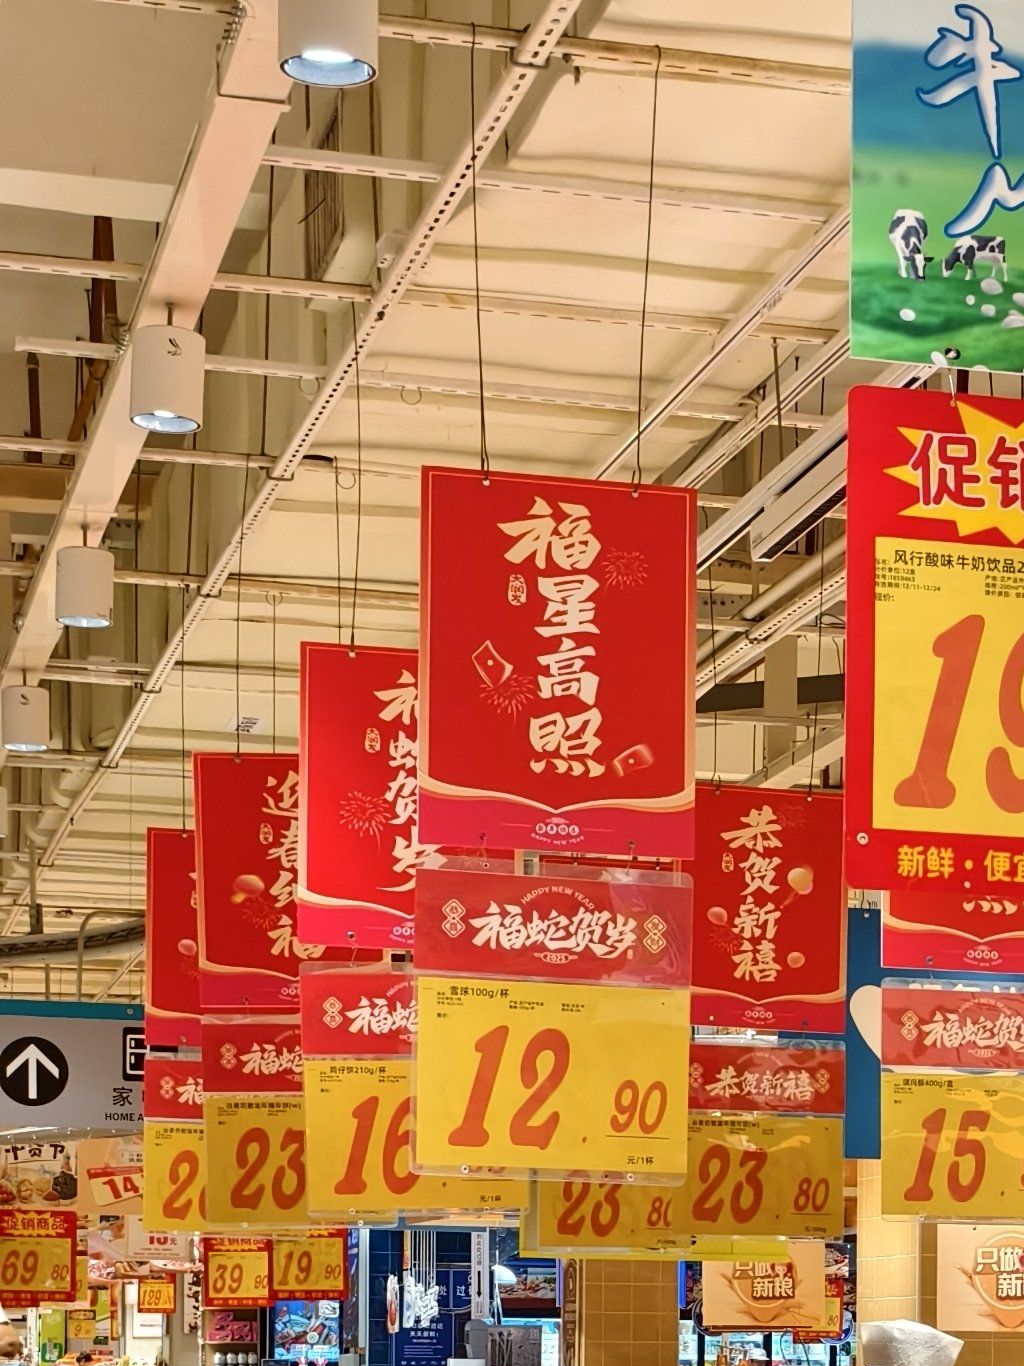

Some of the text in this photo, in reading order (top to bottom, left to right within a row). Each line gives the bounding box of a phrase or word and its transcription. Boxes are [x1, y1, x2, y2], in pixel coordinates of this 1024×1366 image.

[497, 496, 606, 777] 福星高照
[720, 805, 783, 983] 恭贺新禧
[468, 901, 638, 959] 福蛇贺岁
[705, 1065, 814, 1100] 恭贺新禧
[105, 1112, 135, 1122] HOME
[976, 1246, 1024, 1273] 只做
[752, 1277, 794, 1299] 新粮
